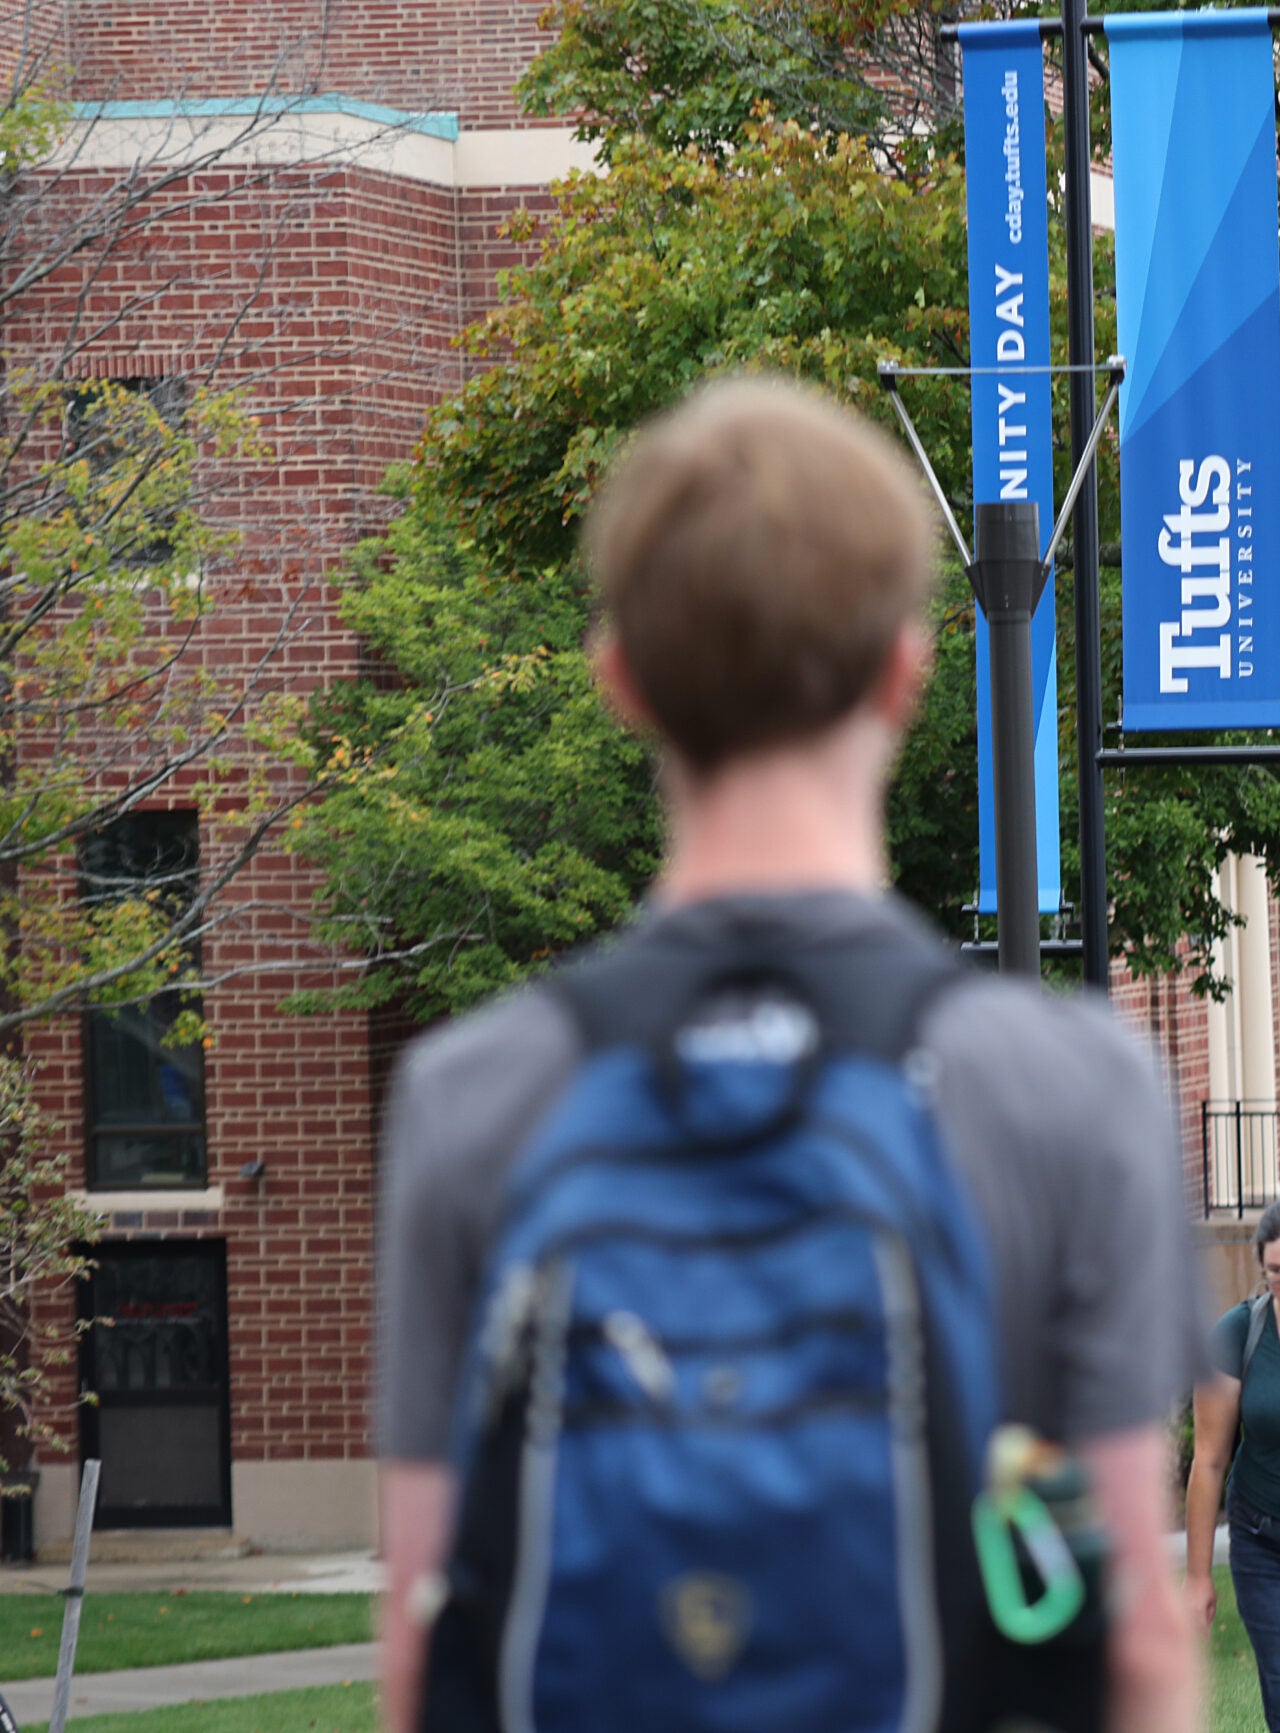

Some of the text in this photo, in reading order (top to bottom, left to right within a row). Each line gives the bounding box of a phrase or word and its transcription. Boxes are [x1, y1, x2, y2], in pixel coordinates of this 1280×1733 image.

[1002, 71, 1024, 244] cday.tufts.edu
[995, 264, 1025, 361] DAY
[1157, 455, 1231, 693] Tufts
[1236, 458, 1254, 678] UNIVERSITY
